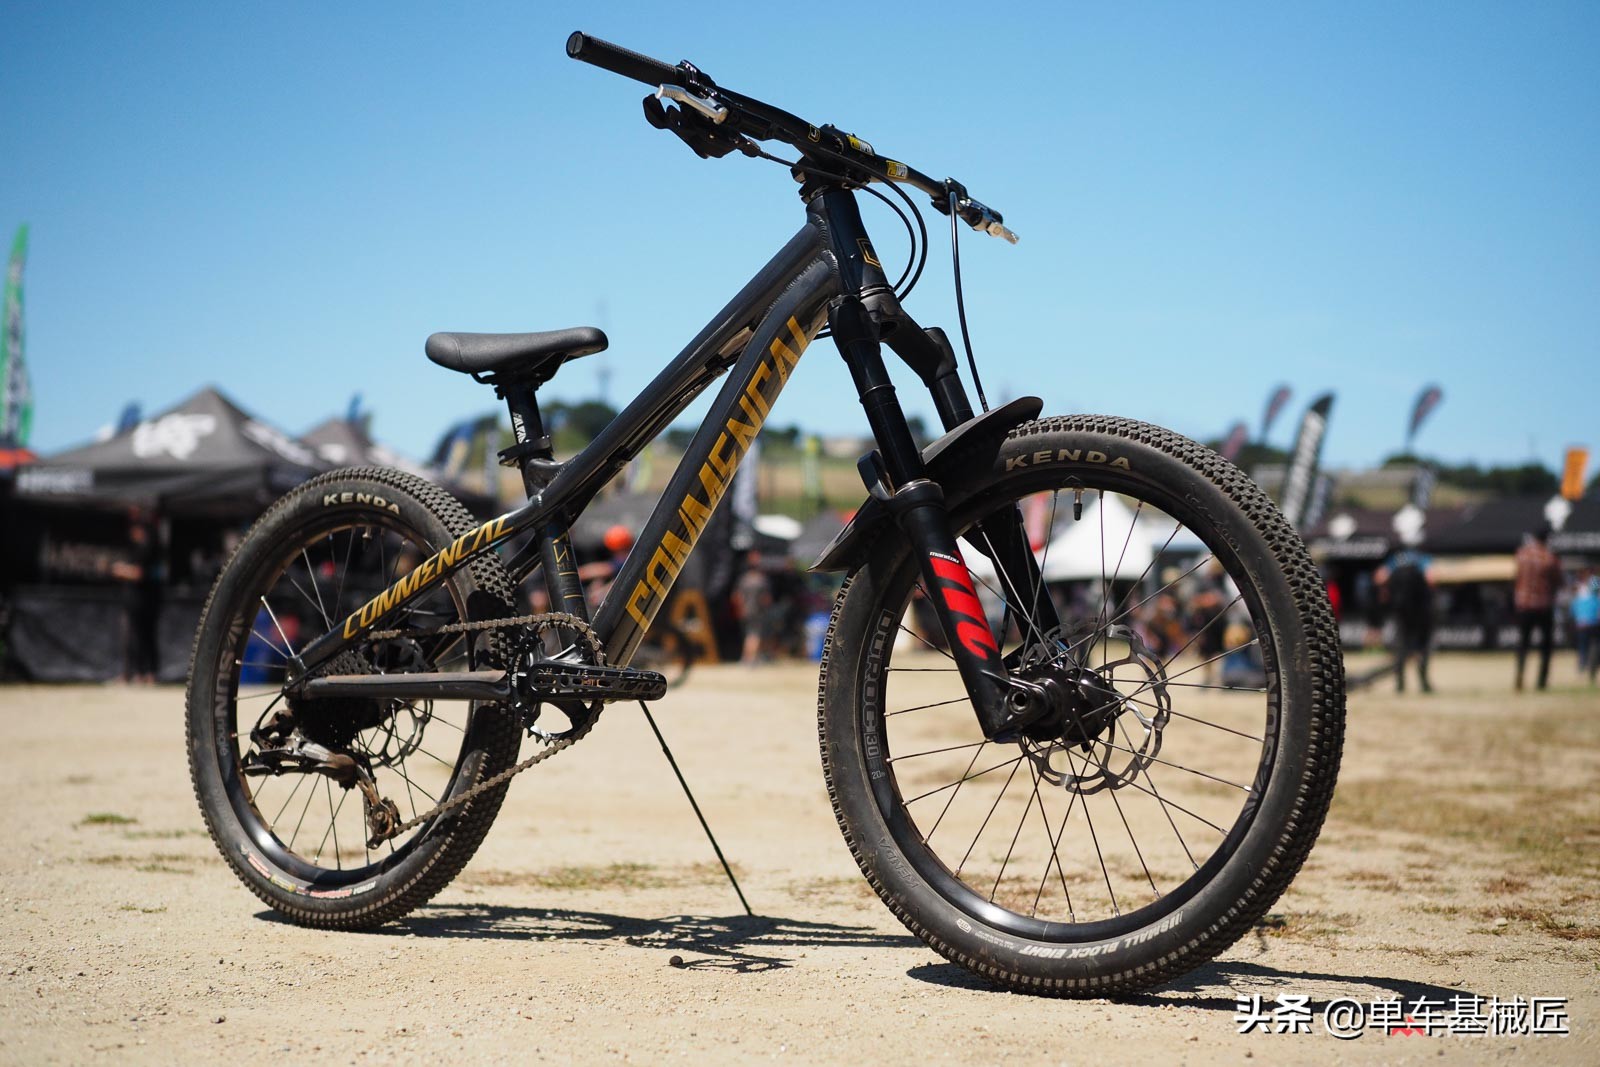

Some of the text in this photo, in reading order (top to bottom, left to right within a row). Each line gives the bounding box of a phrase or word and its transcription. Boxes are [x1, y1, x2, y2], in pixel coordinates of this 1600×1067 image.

[1005, 449, 1131, 472] KENDA
[323, 492, 399, 514] KENDA
[343, 513, 514, 639] COMMENCAL
[215, 650, 235, 717] SUN
[863, 609, 895, 729] DUROC
[1018, 919, 1171, 960] SMALL BLOCK EIGHT
